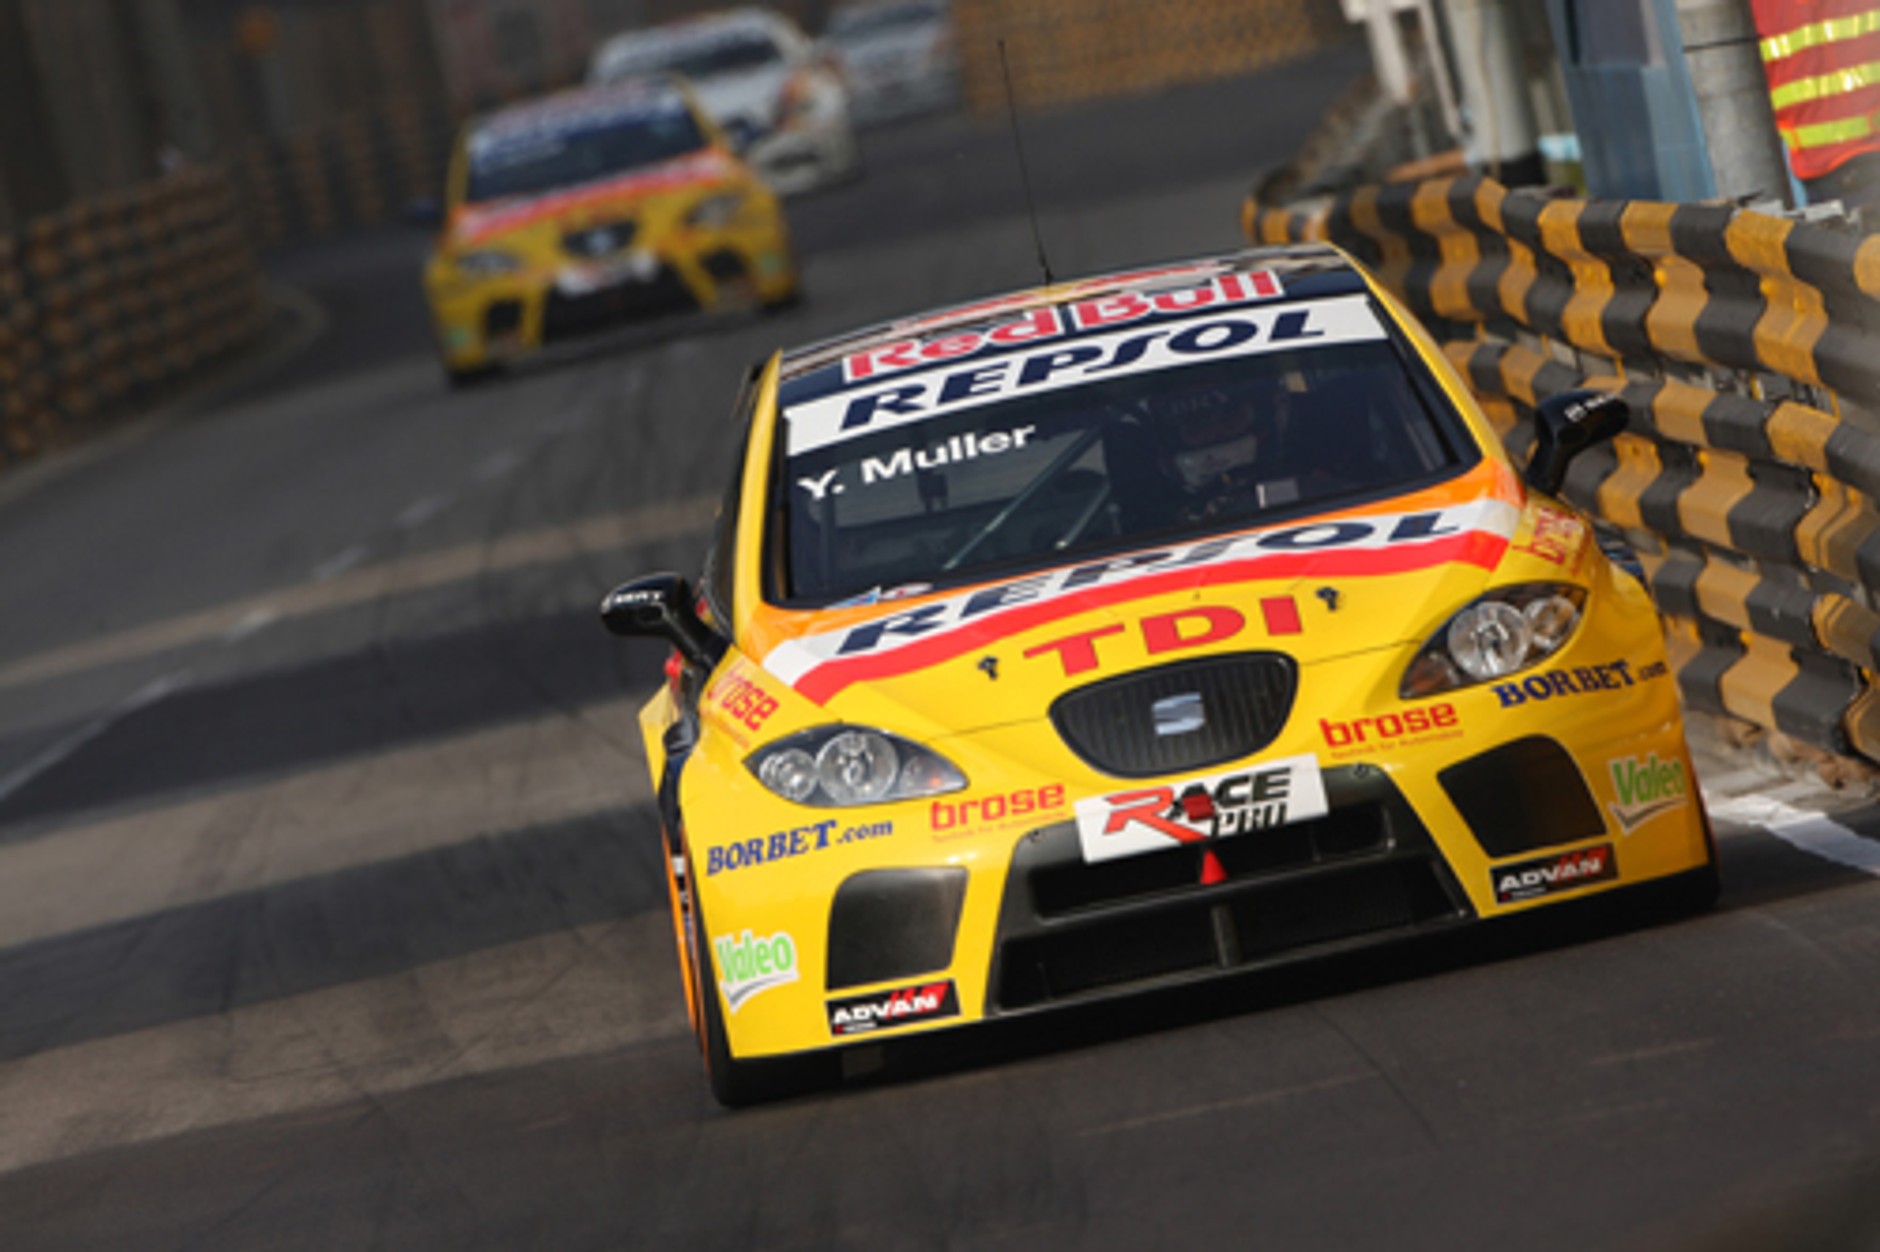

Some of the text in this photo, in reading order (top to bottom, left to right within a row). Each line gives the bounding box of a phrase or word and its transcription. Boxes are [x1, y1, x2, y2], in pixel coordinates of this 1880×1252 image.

[843, 269, 1285, 384] Red Bull
[841, 311, 1325, 430] REPSOL
[798, 425, 1036, 500] Y. Muller
[836, 513, 1460, 655] REPSOL
[1023, 597, 1303, 677] TDI
[1319, 702, 1459, 748] brose
[930, 783, 1065, 831] brose
[707, 820, 893, 876] BORBET.com
[1500, 857, 1602, 892] ADVAN
[833, 993, 938, 1024] ADVAN
